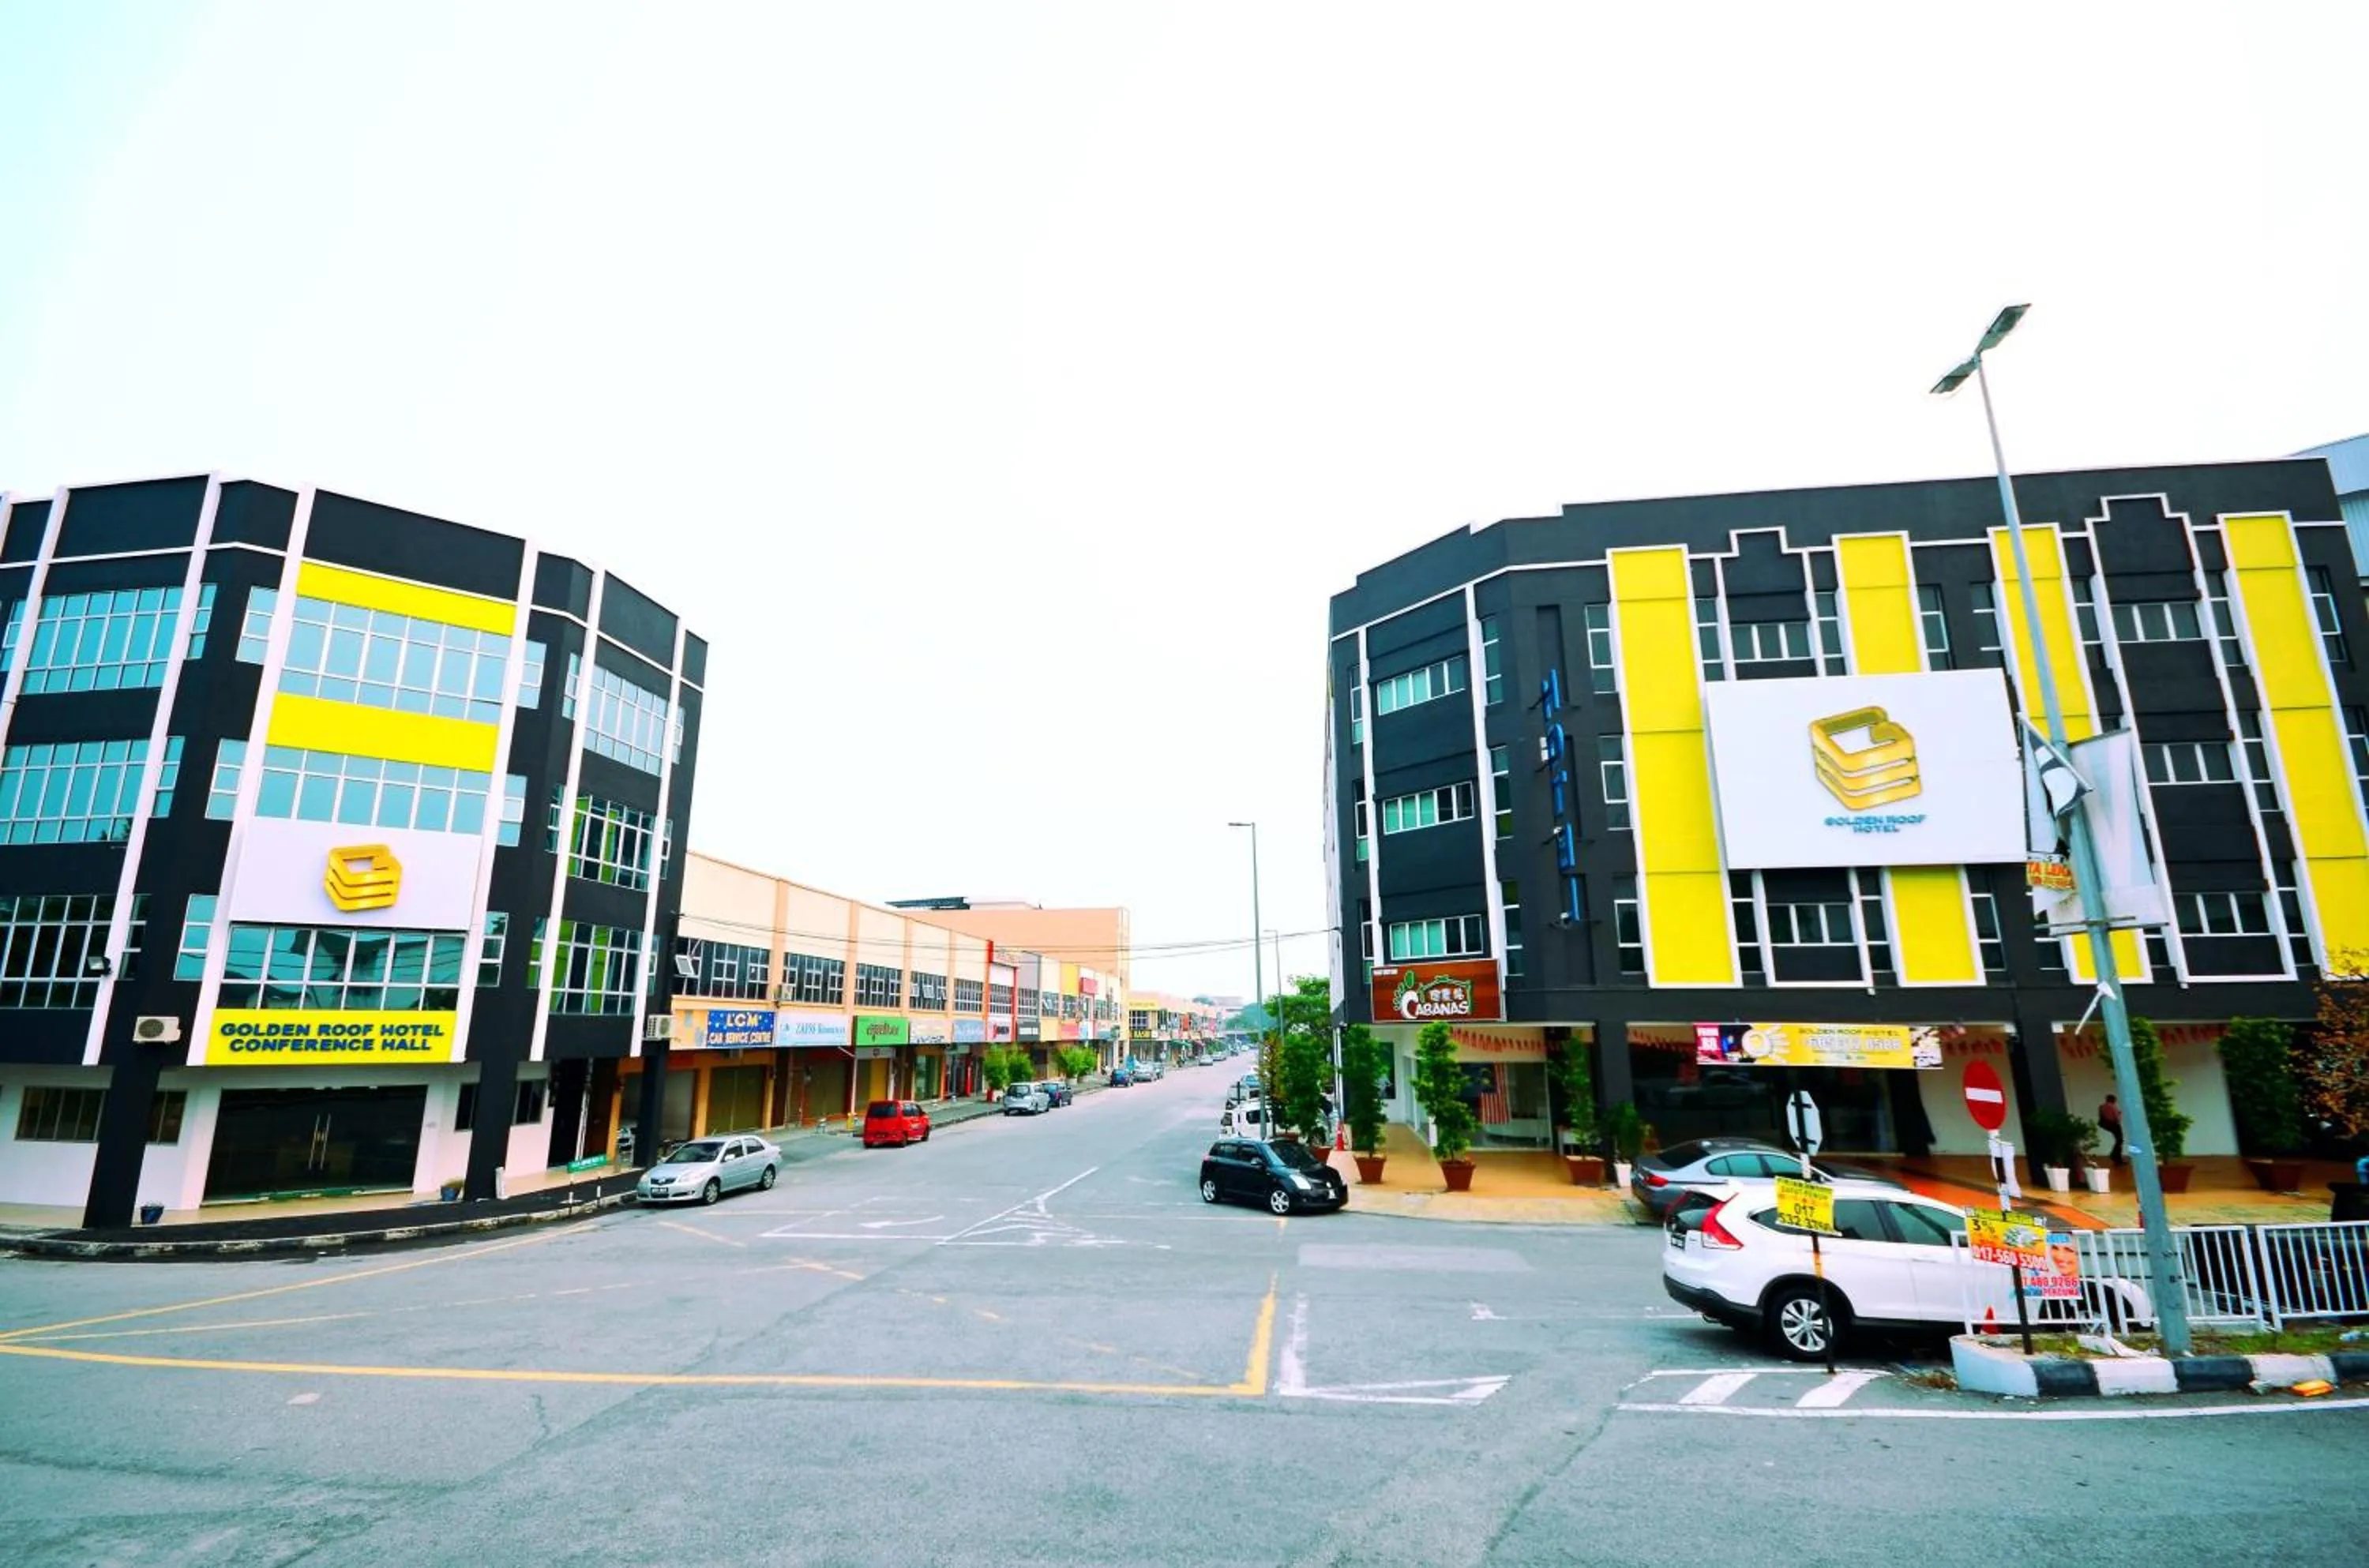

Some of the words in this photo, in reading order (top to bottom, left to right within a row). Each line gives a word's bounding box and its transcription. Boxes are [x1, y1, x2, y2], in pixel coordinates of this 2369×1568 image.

[1542, 669, 1580, 921] HOTEL
[1824, 816, 1884, 826] GOLDEN
[1886, 813, 1927, 825] ROOF
[1852, 824, 1901, 834] HOTEL
[1400, 989, 1469, 1019] CABANAS
[220, 1022, 311, 1037] GOLDEN
[317, 1023, 374, 1037] ROOF
[381, 1023, 445, 1037] HOTEL
[725, 1031, 749, 1044] SERVICE
[229, 1038, 375, 1052] CONFERENCE
[381, 1038, 432, 1051] HALL
[1793, 1202, 1815, 1217] 017
